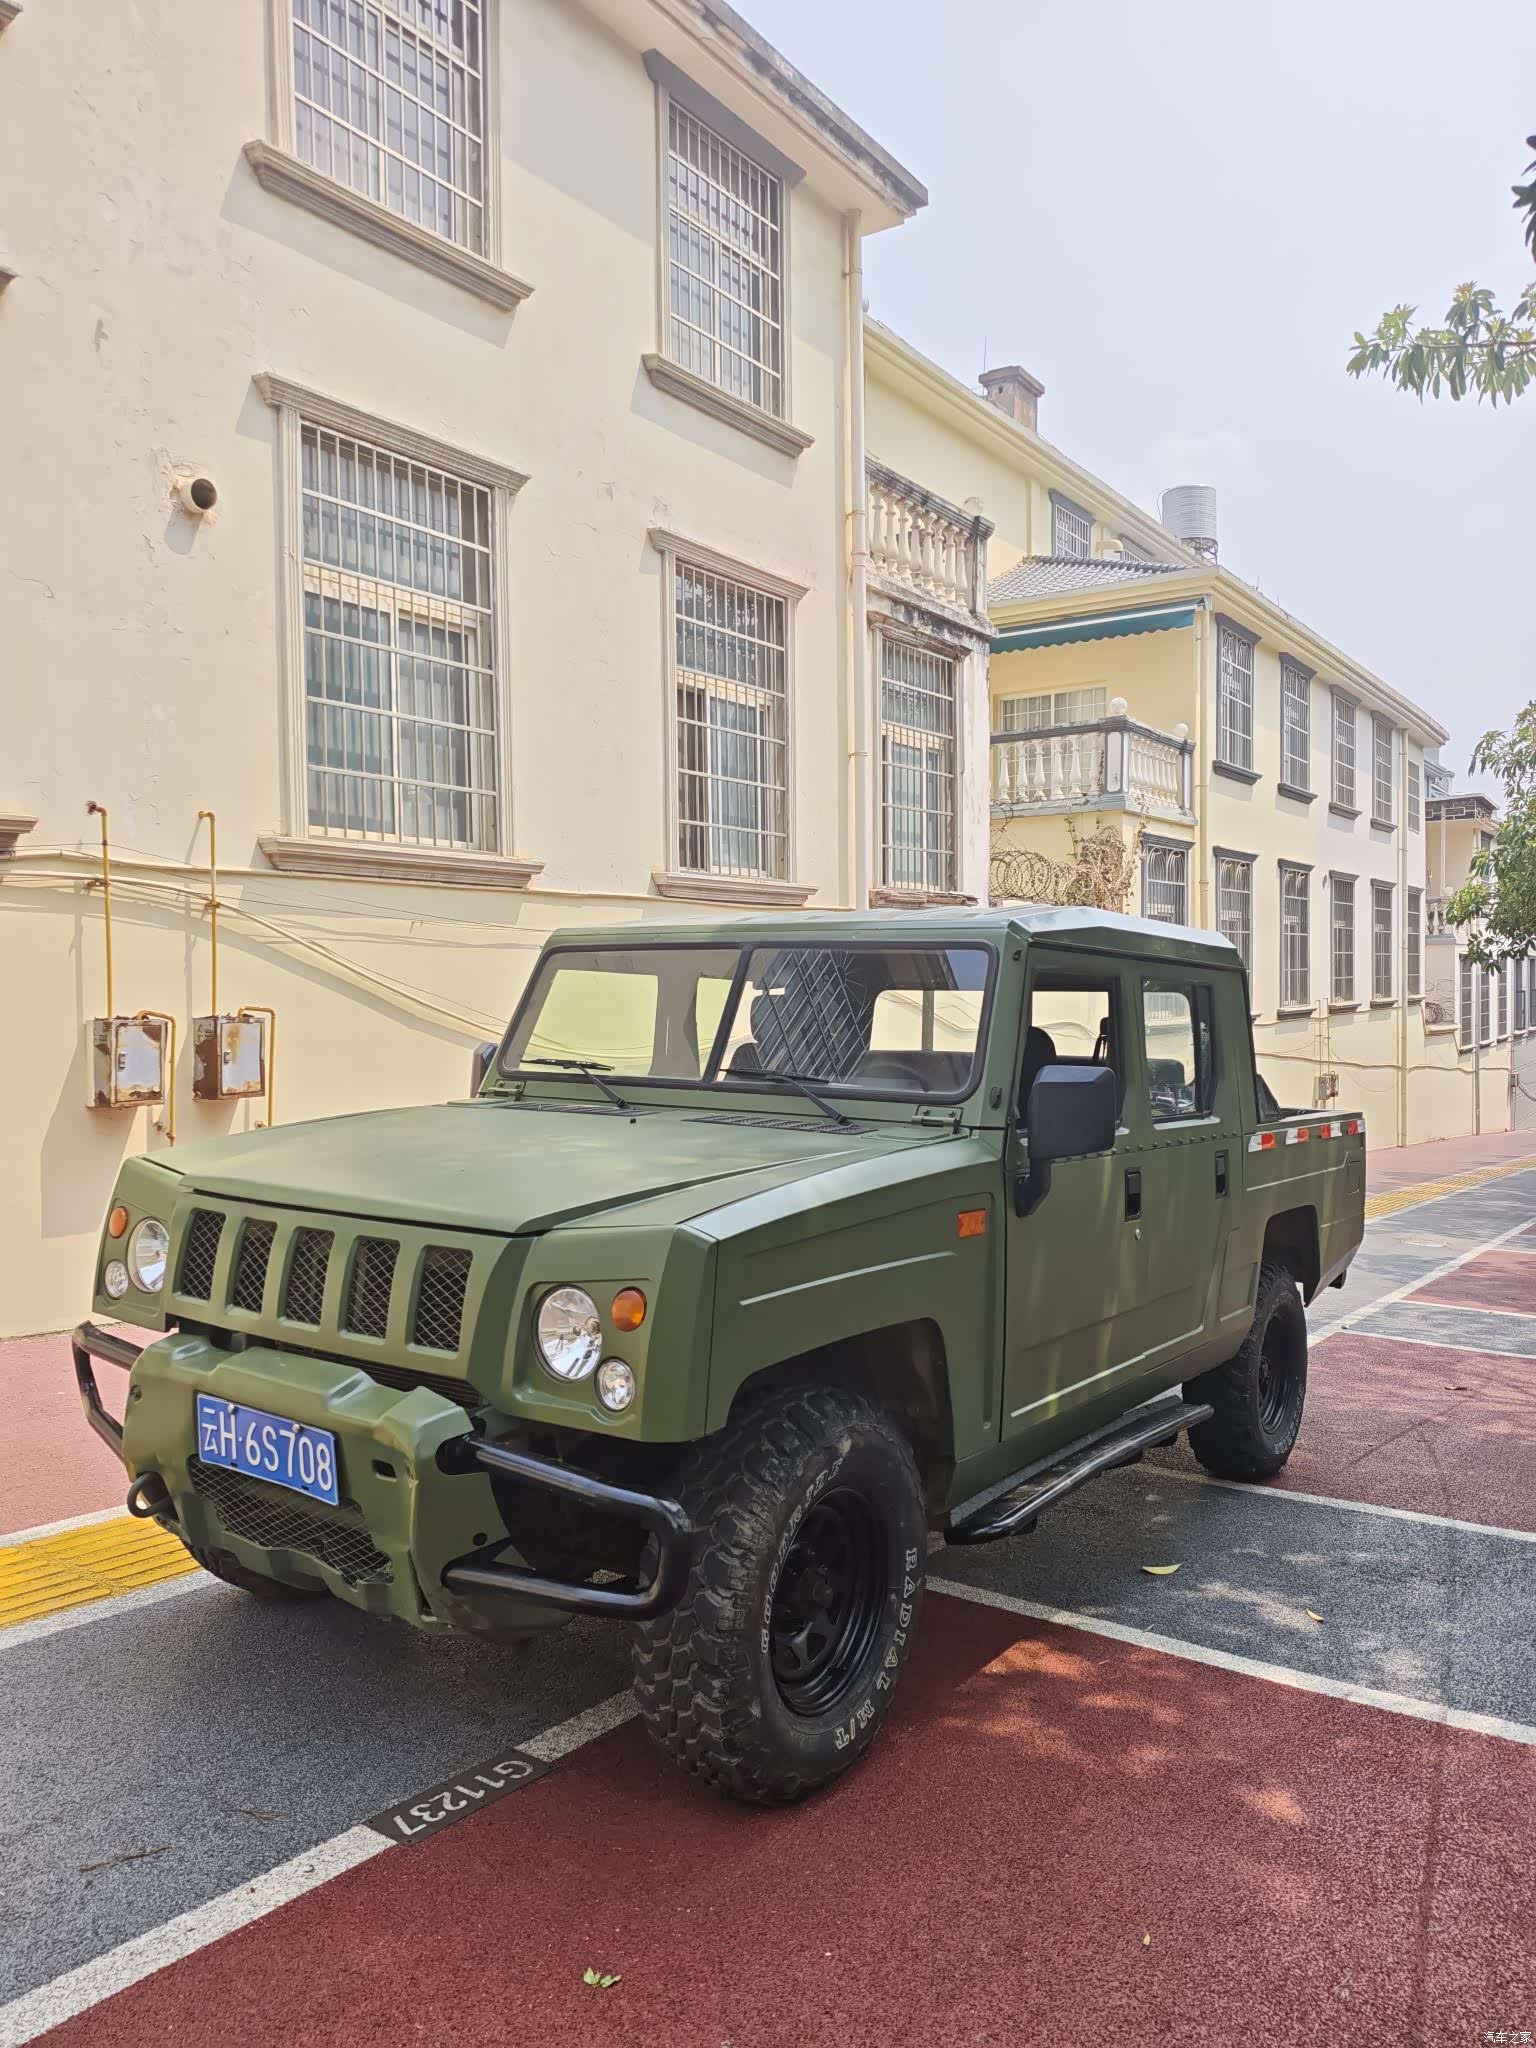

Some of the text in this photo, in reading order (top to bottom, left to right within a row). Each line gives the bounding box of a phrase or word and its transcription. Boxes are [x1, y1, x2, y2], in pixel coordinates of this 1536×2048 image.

[202, 1407, 333, 1492] 云H·6S708
[834, 1547, 918, 1750] RADIAL M/T
[393, 1760, 534, 1836] G11237
